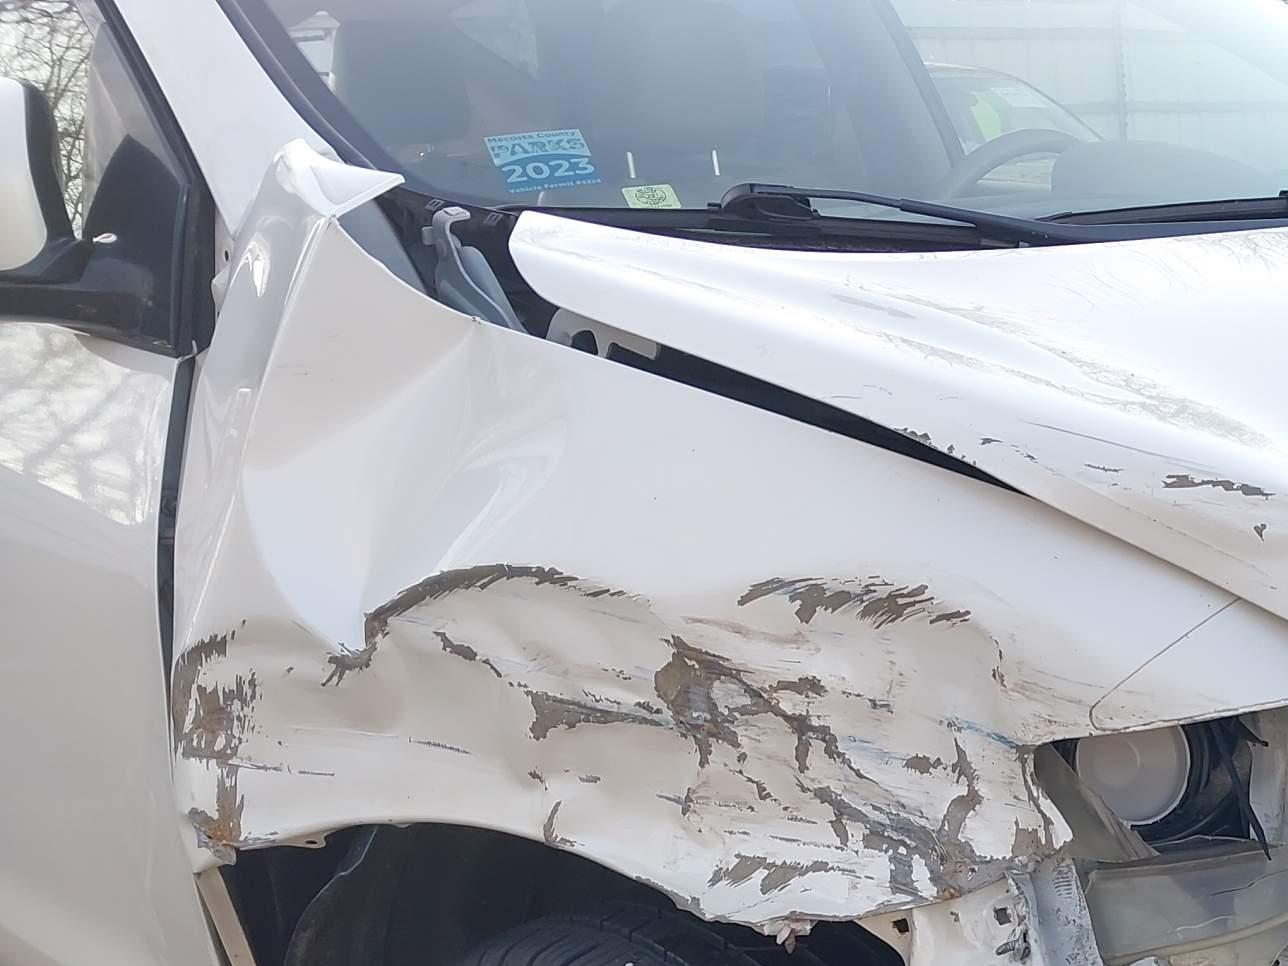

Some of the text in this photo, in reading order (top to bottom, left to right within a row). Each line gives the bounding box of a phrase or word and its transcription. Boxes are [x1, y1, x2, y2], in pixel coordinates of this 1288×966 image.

[536, 130, 577, 140] County
[490, 138, 586, 159] PARKS
[501, 157, 595, 183] 2023
